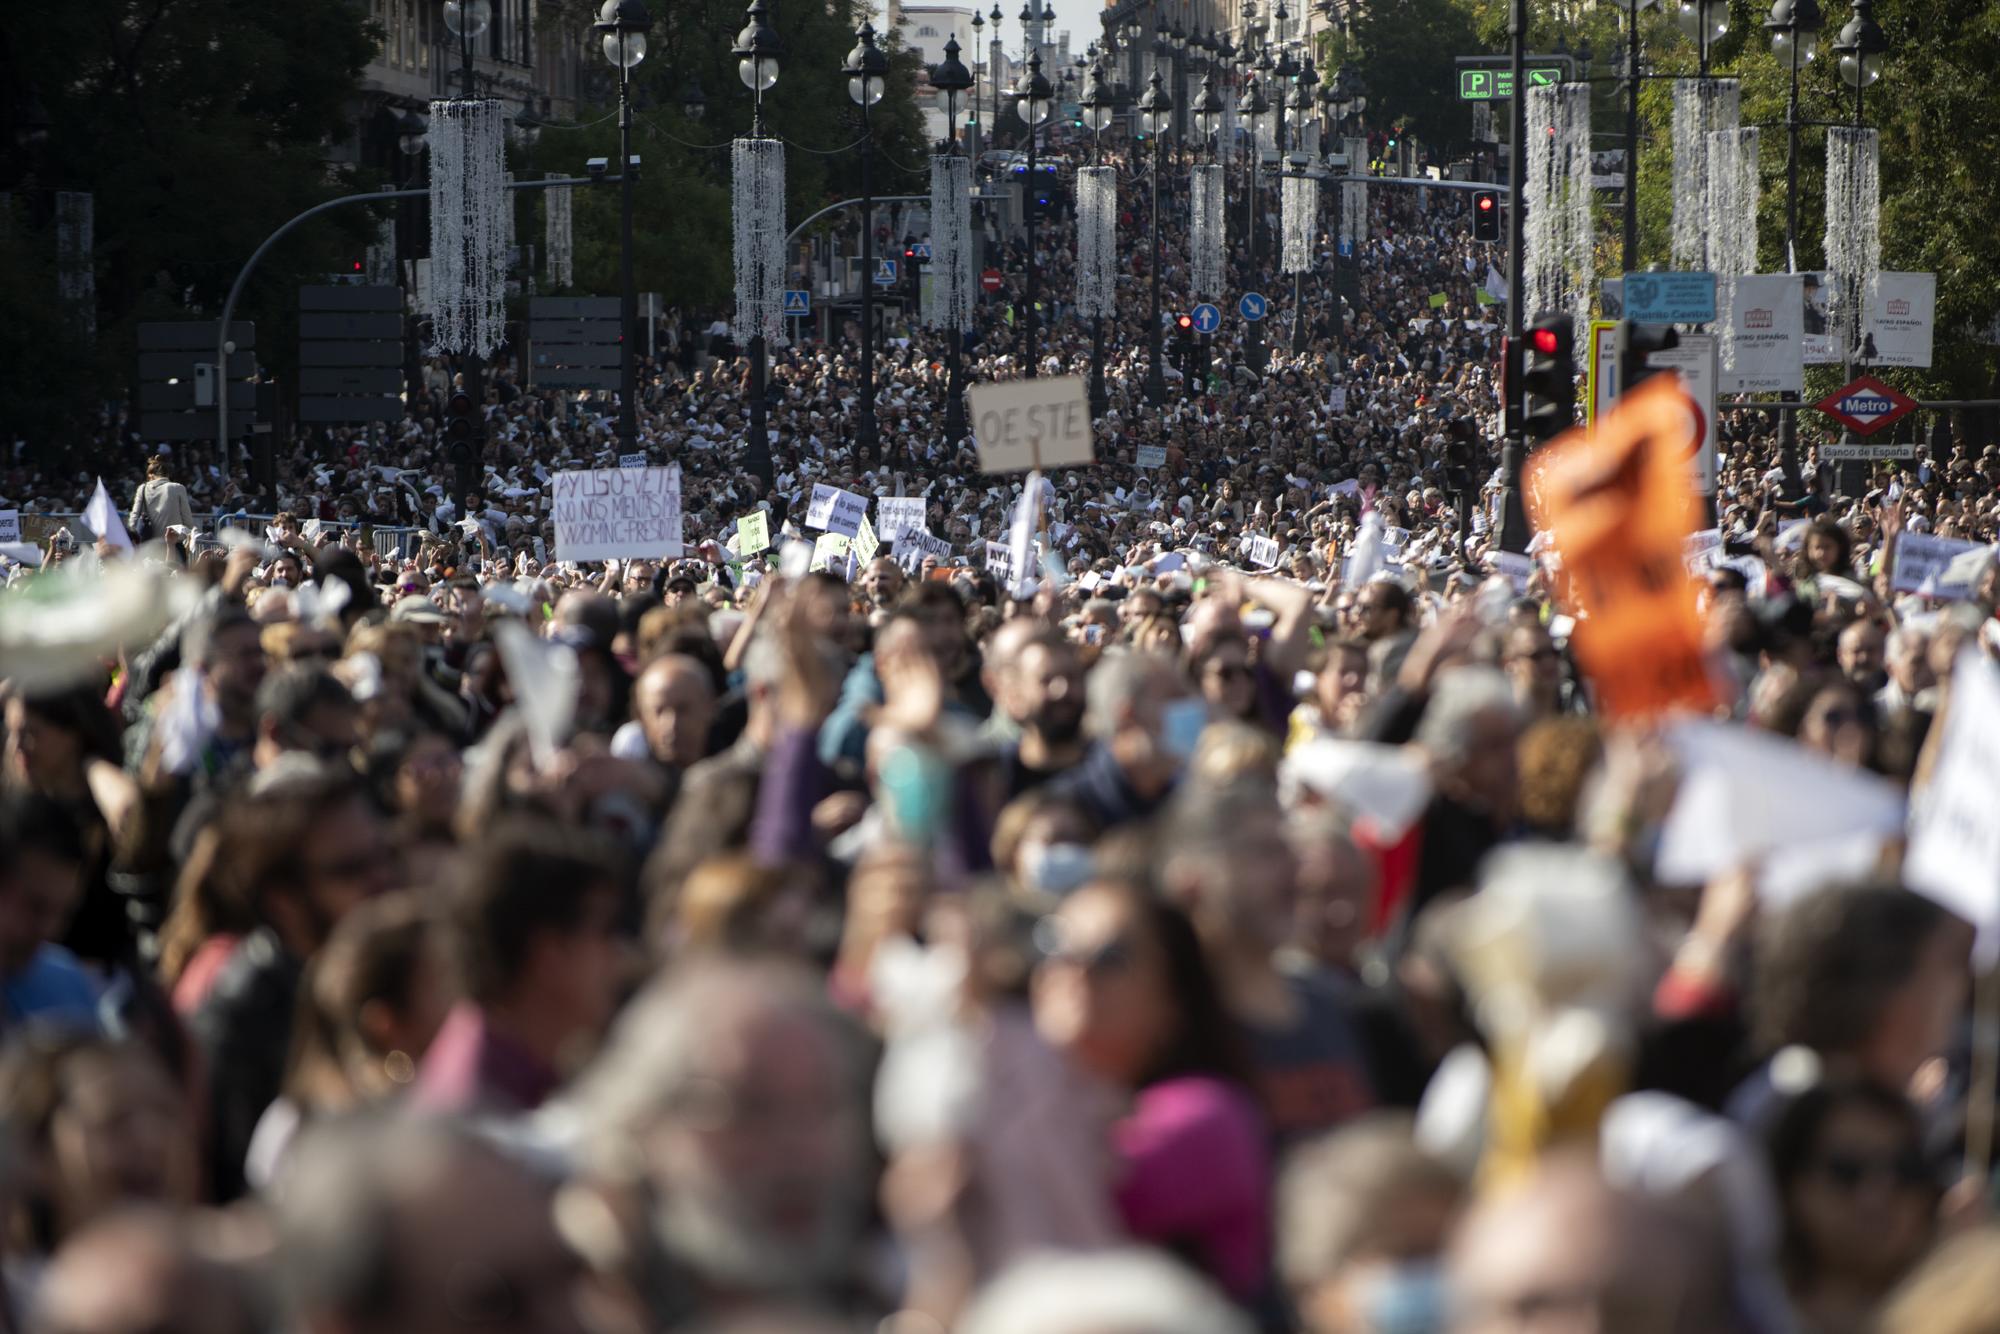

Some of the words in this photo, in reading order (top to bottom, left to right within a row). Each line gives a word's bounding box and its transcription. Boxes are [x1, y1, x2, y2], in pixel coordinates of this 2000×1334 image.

[1472, 74, 1484, 91] P
[1630, 310, 1669, 320] Distrito
[1671, 309, 1712, 318] Centro
[1846, 399, 1888, 412] Metro
[1824, 447, 1855, 457] Banco
[1858, 447, 1870, 457] de
[1872, 447, 1909, 458] España
[814, 491, 831, 506] Amig
[911, 530, 949, 557] SANIDAD
[990, 549, 1013, 563] AYU
